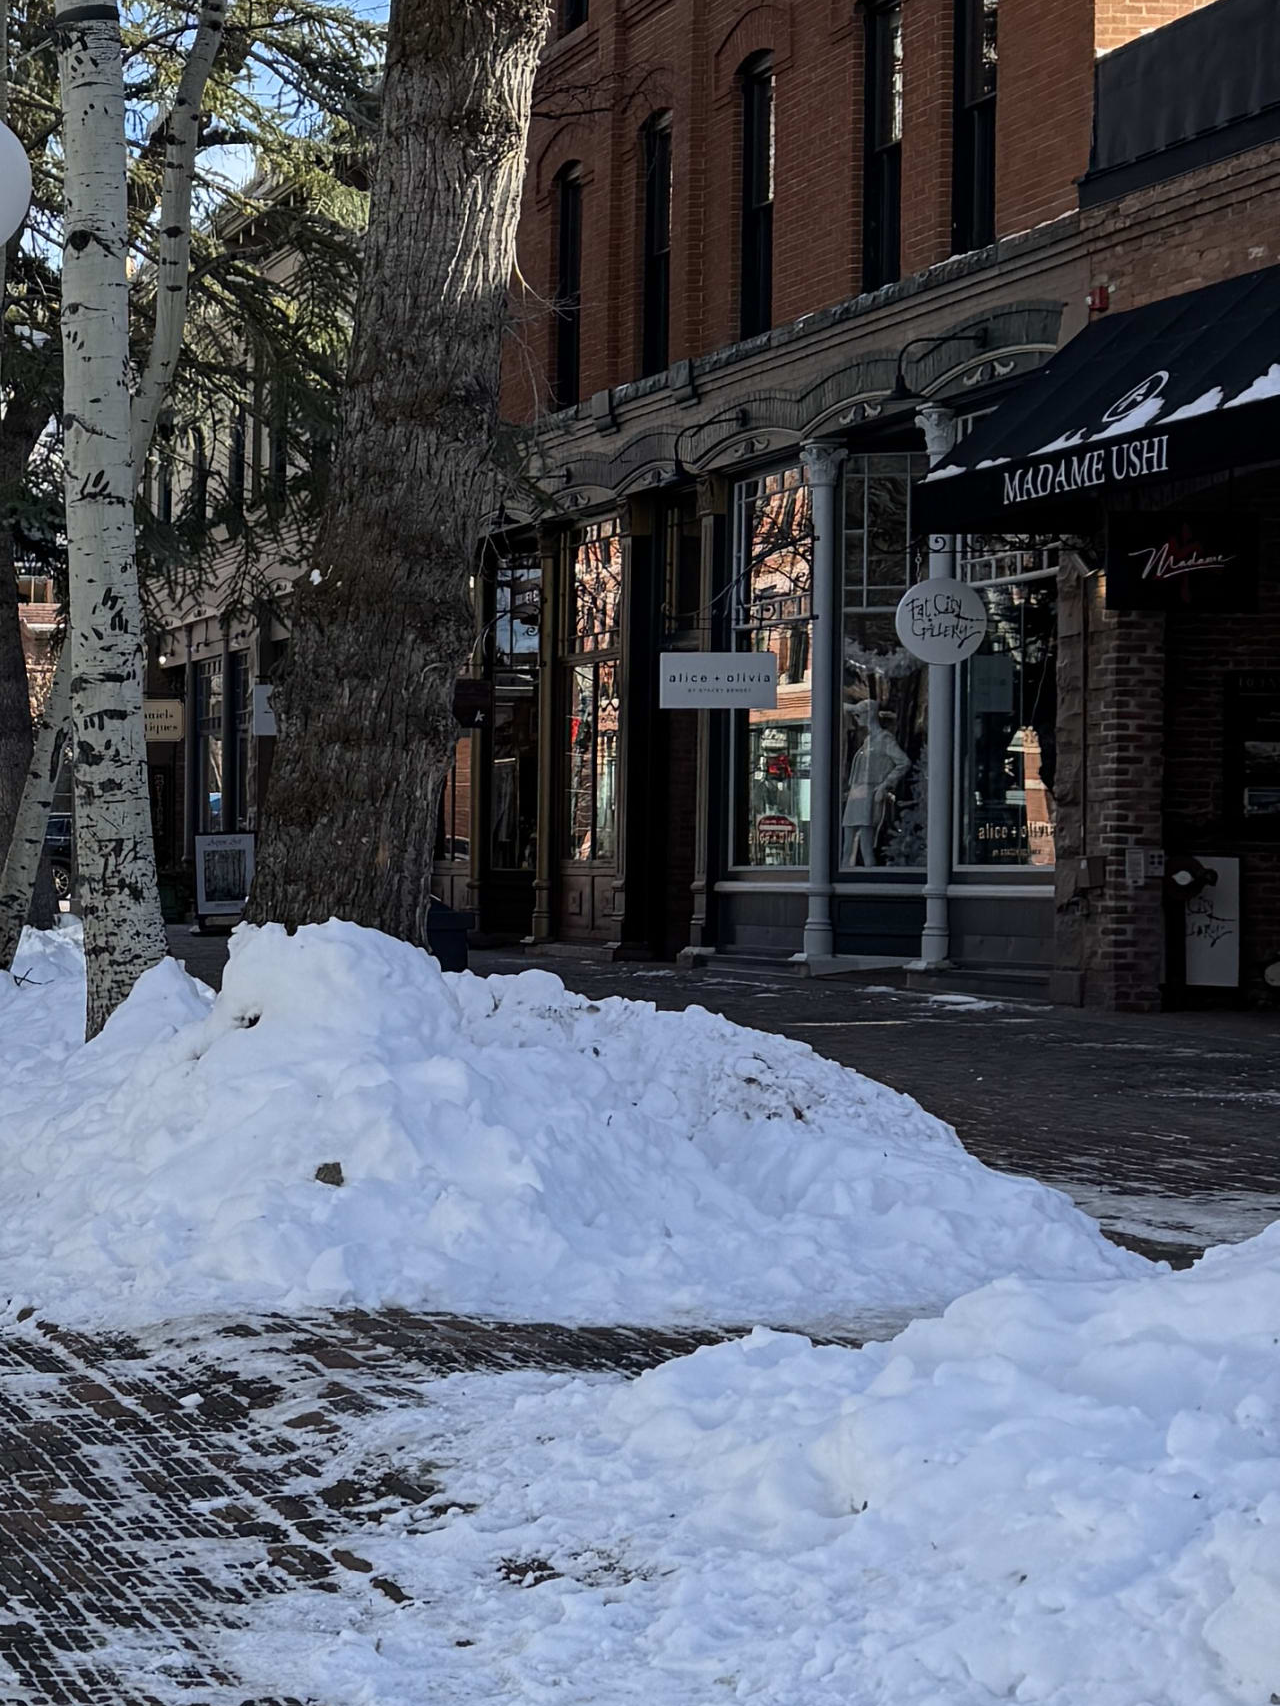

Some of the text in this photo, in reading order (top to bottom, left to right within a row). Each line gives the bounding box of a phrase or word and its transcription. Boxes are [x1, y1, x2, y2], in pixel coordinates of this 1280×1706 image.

[1003, 450, 1105, 505] MADAME
[1111, 435, 1169, 480] USHI
[669, 672, 708, 683] alice
[726, 672, 771, 683] olivia
[144, 722, 178, 734] tiques
